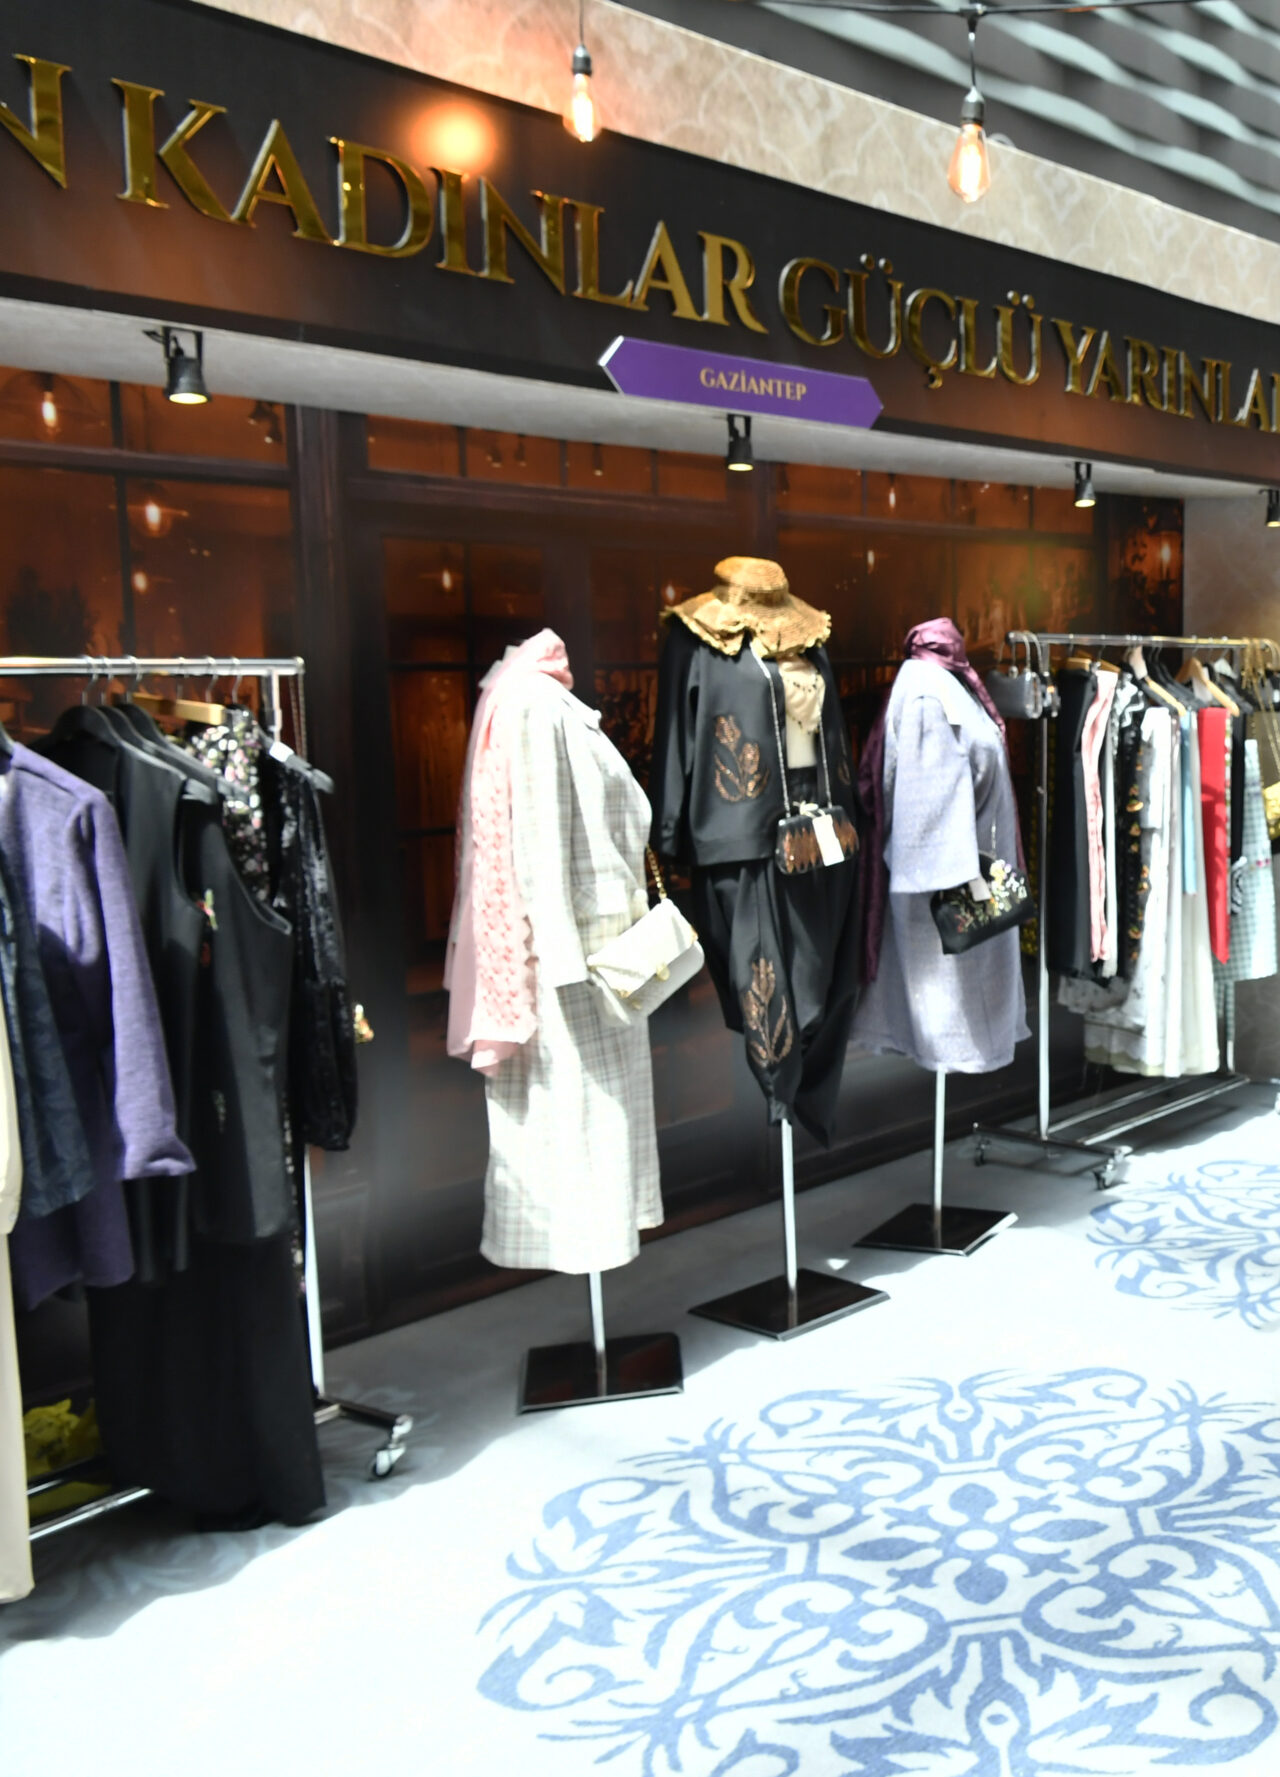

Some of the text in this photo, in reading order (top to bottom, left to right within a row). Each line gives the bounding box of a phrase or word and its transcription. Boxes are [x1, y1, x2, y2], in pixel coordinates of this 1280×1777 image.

[110, 77, 769, 335] KADINLAR
[778, 253, 1043, 389] GÜÇLÜ
[699, 367, 808, 401] GAZİANTEP
